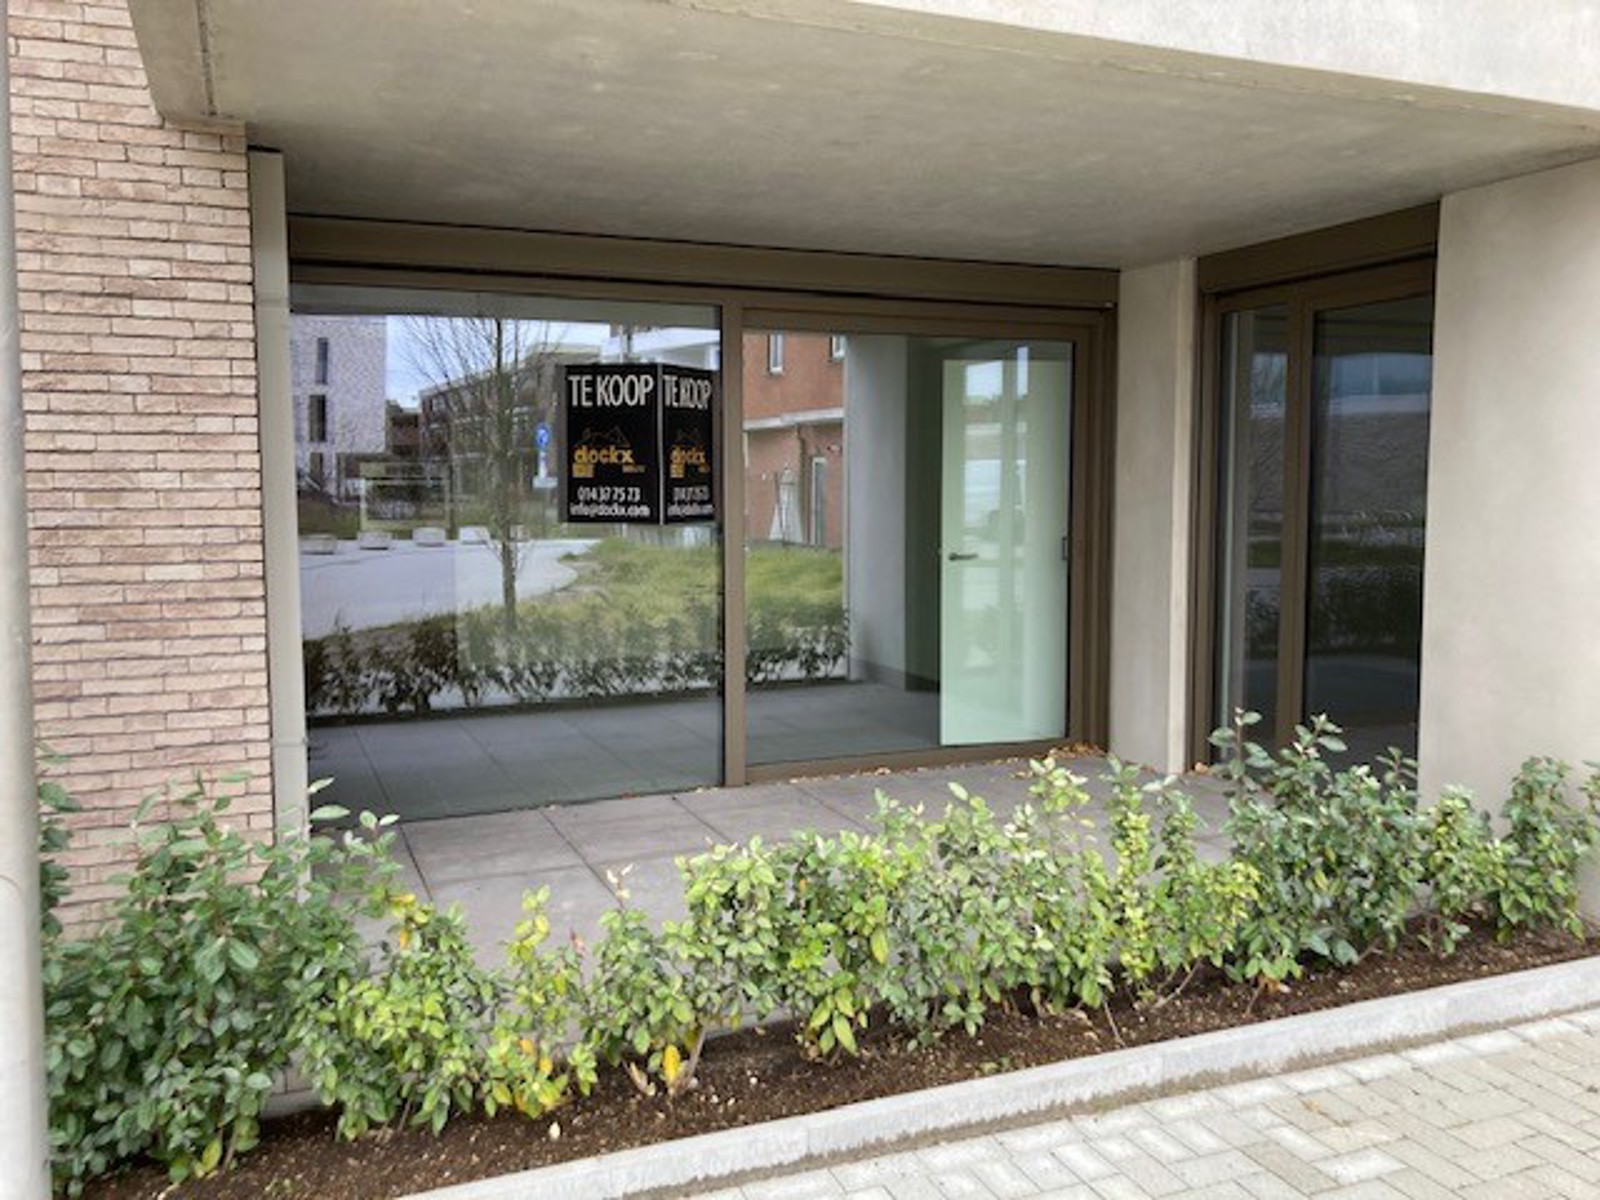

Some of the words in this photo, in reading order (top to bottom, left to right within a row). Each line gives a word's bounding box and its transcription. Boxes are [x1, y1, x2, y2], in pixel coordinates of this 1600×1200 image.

[568, 374, 593, 407] TE
[596, 374, 654, 407] KOOP
[663, 374, 679, 408] TE
[680, 376, 712, 410] KOOP
[574, 444, 634, 464] dockx
